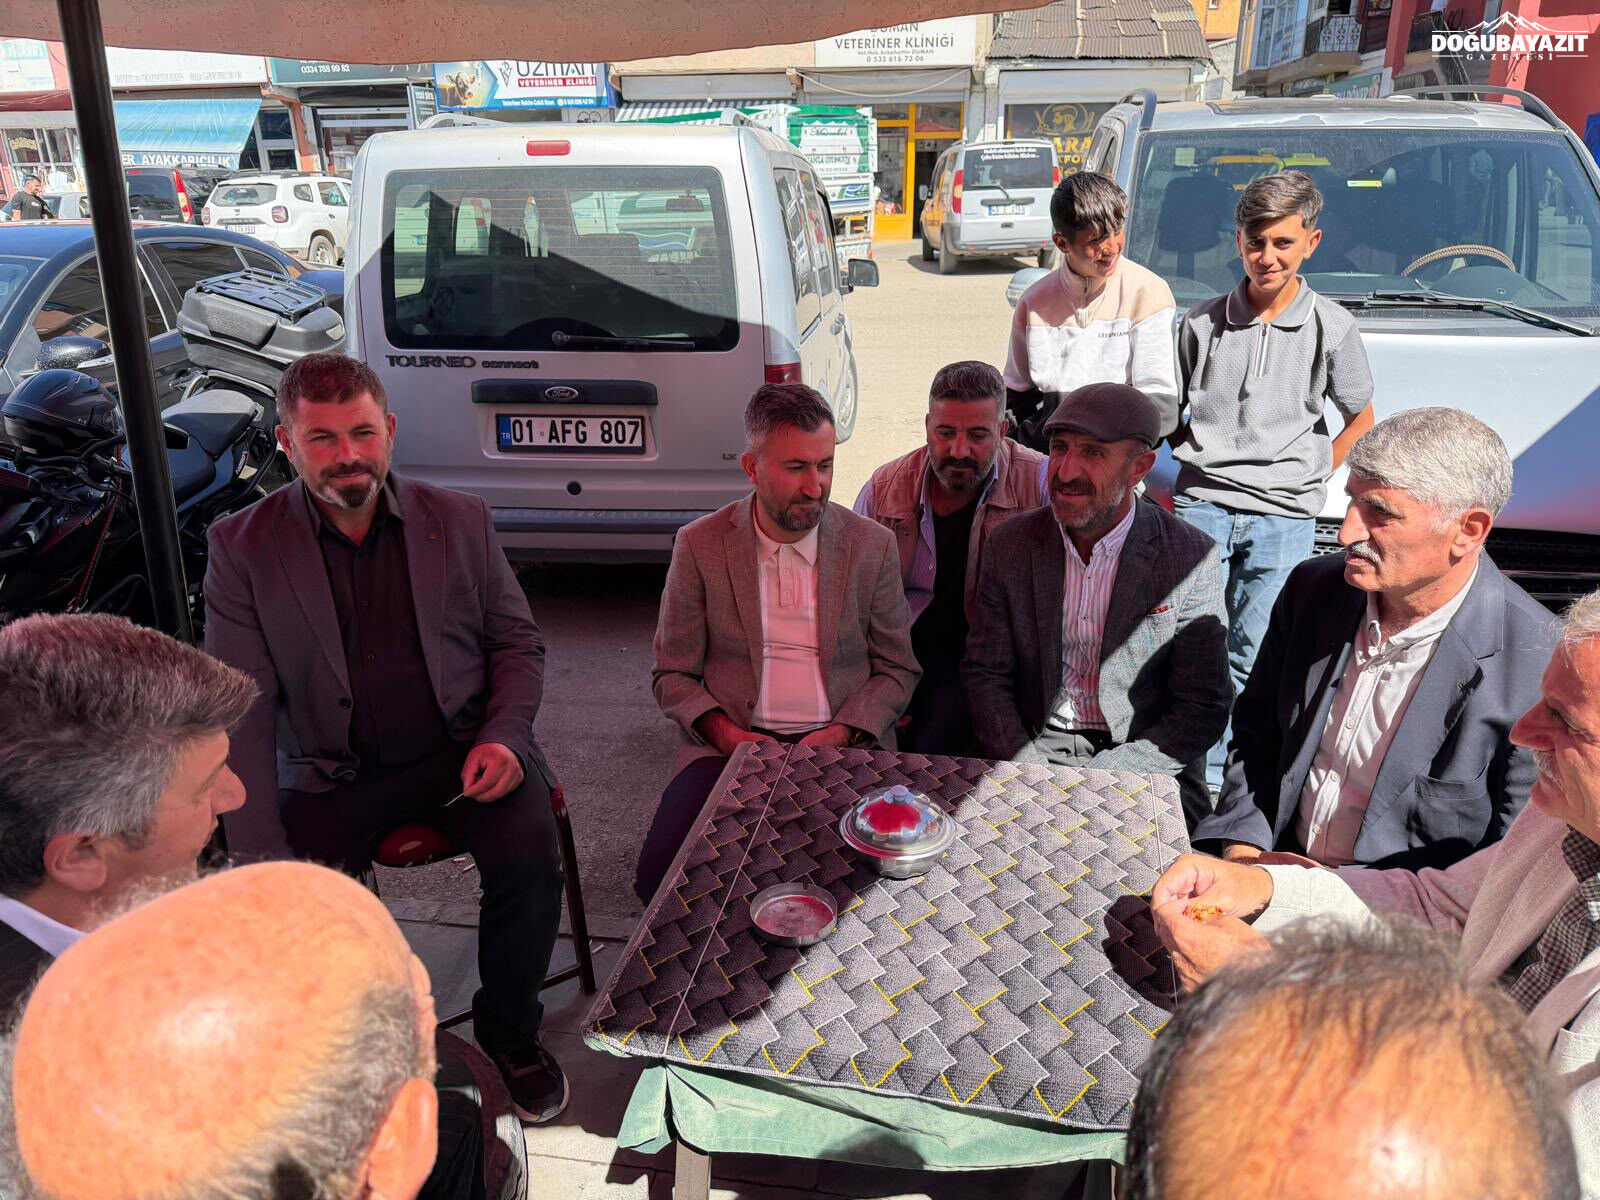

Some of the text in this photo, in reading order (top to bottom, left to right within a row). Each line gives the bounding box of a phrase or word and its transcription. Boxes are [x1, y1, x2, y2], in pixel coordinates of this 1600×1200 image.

[835, 33, 954, 49] VETERİNER KLİNİĞİ
[385, 354, 539, 369] TOURNEO connect
[512, 419, 534, 443] 01
[548, 420, 588, 444] AFG
[600, 420, 640, 445] 807
